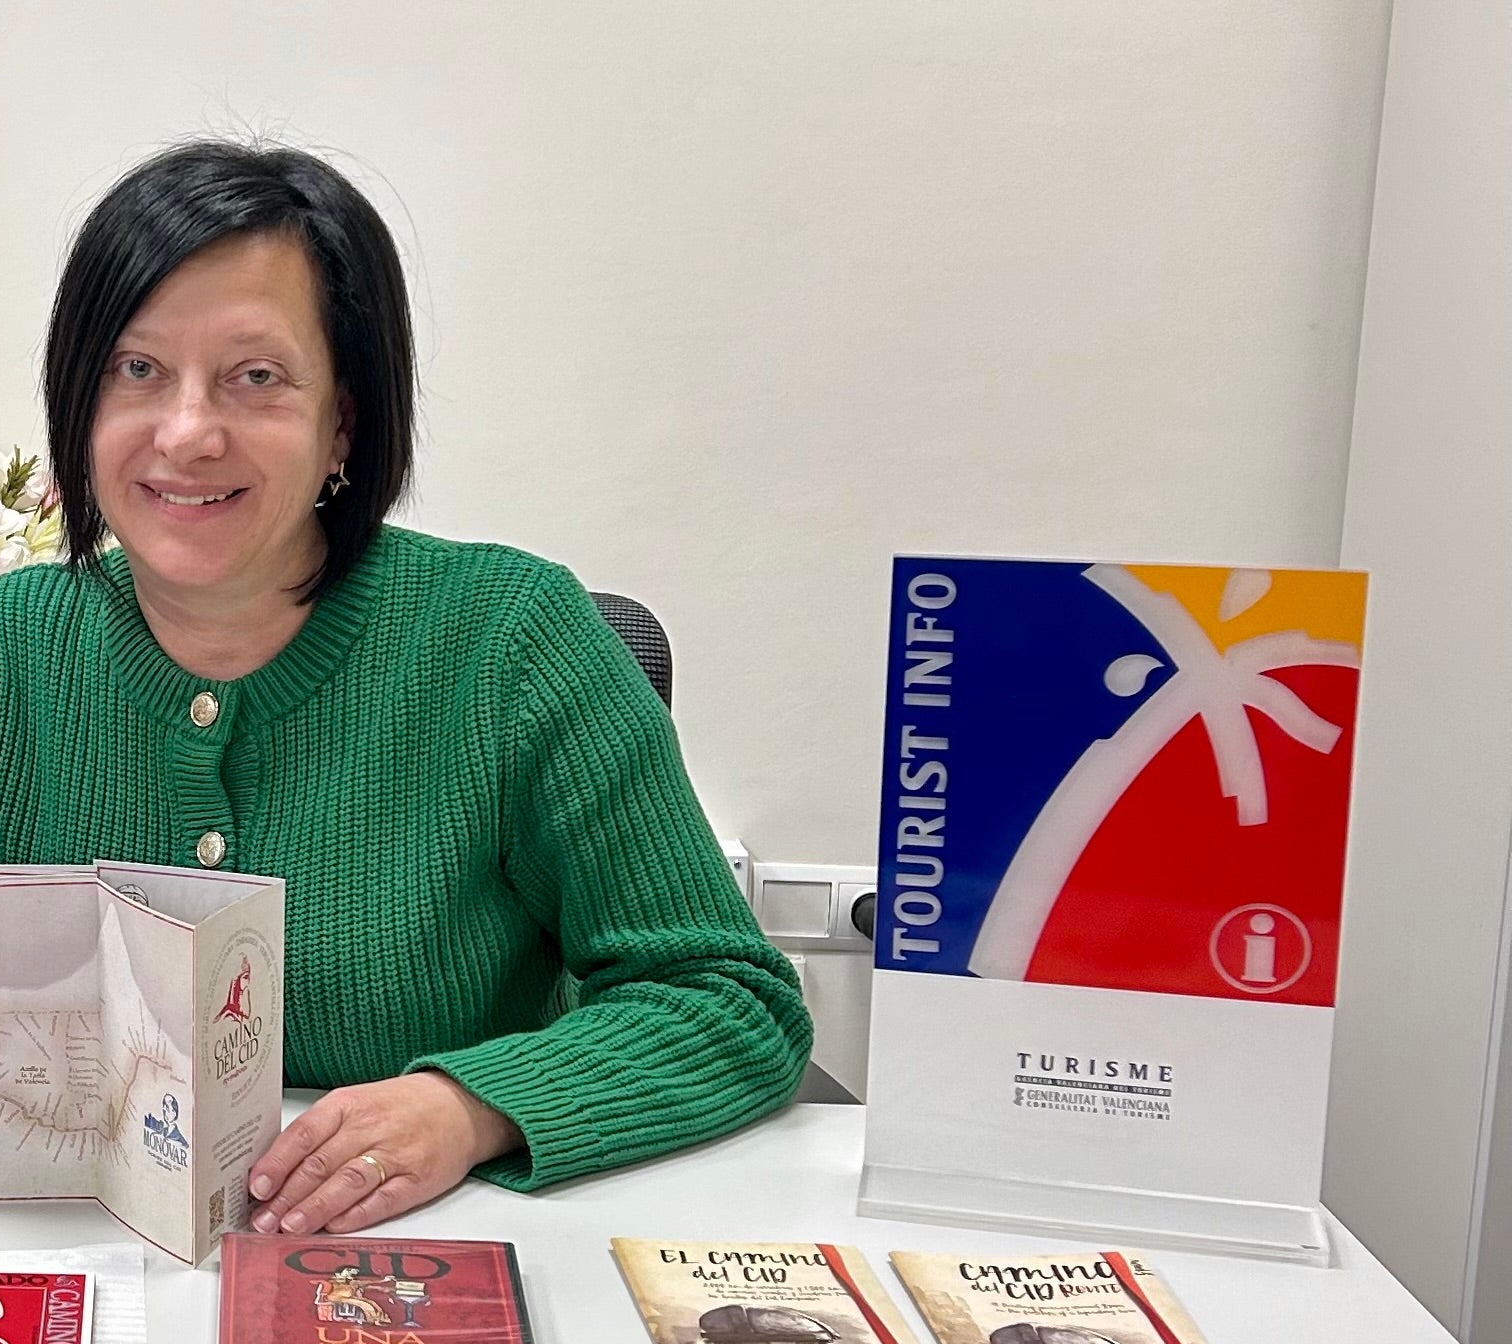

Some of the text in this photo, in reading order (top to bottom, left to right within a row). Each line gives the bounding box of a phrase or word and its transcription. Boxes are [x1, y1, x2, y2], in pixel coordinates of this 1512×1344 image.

[891, 571, 959, 962] TOURIST INFO
[214, 1016, 262, 1060] CAMINO
[216, 1051, 236, 1080] DEL
[239, 1038, 258, 1064] CID
[1017, 1052, 1173, 1083] TURISME
[1027, 1089, 1171, 1113] GENERALITAT VALENCIANA
[285, 1247, 452, 1280] CID
[692, 1265, 787, 1283] del CID
[1005, 1282, 1054, 1301] CID
